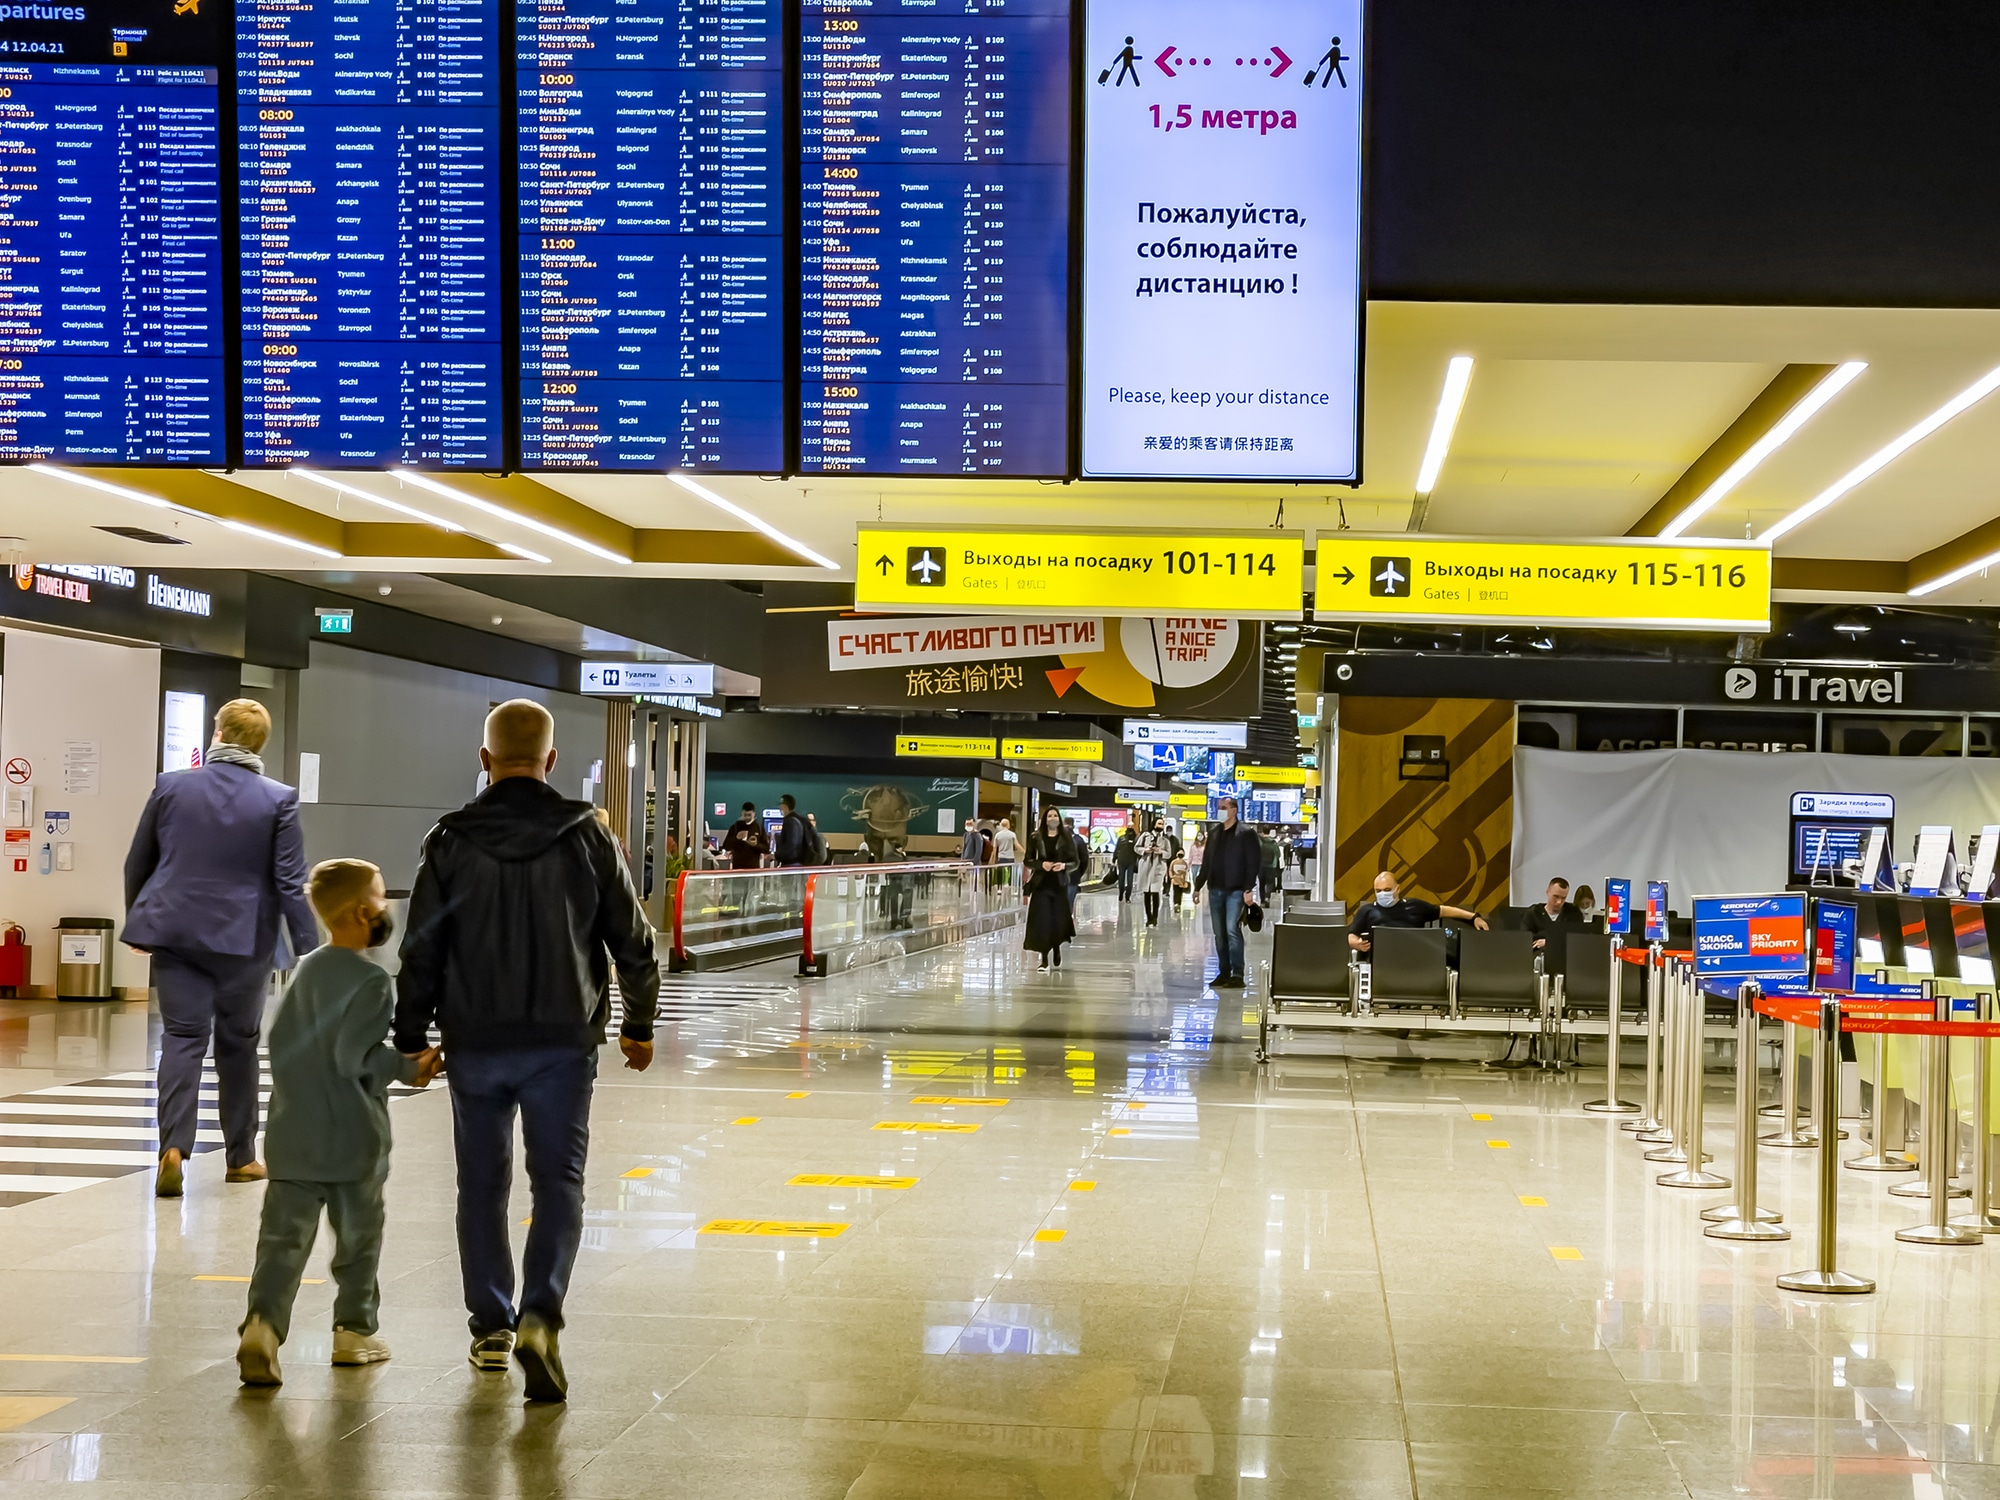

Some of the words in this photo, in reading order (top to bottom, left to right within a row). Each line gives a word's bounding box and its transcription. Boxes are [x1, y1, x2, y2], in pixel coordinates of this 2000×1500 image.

[257, 15, 291, 23] Иркутск
[824, 20, 858, 31] 13:00
[13, 42, 64, 52] 12.04.21
[258, 51, 278, 59] Сочи
[540, 75, 573, 84] 10:00
[539, 90, 583, 98] Волгоград
[616, 90, 653, 98] Volgograd
[55, 105, 96, 113] N.Novgorod
[259, 109, 293, 120] 08:00
[1149, 104, 1193, 132] 1,5
[1202, 109, 1297, 134] метра
[823, 128, 856, 136] Самара
[260, 161, 291, 169] Самара
[824, 168, 858, 178] 14:00
[901, 184, 928, 192] Tyumen
[58, 196, 91, 204] Orenburg
[1137, 202, 1307, 229] Пожалуйста,
[542, 239, 575, 249] 11:00
[1137, 237, 1298, 262] соблюдайте
[61, 268, 83, 276] Surgut
[541, 272, 562, 280] Орск
[823, 275, 869, 283] Краснодар
[1136, 276, 1285, 297] дистанцию
[1292, 273, 1298, 294] !
[823, 311, 849, 319] Магас
[901, 312, 924, 320] Magas
[263, 345, 297, 356] 09:00
[543, 384, 576, 394] 12:00
[824, 387, 857, 397] 15:00
[1109, 388, 1165, 404] Please,
[1171, 388, 1211, 406] keep
[1215, 391, 1253, 406] your
[1258, 389, 1329, 404] distance
[542, 416, 563, 424] Сочи
[265, 431, 281, 440] Уфа
[1144, 436, 1294, 451] 亲爱的乘客请保持距离
[265, 449, 310, 458] Краснодар
[823, 456, 866, 465] Мурманск
[964, 550, 1043, 569] Выходы
[1047, 556, 1068, 567] на
[1075, 555, 1153, 572] посадку
[1163, 551, 1276, 577] 101-114
[1425, 561, 1504, 579] Выходы
[1511, 567, 1531, 578] на
[1538, 567, 1617, 584] посадку
[1628, 562, 1746, 588] 115-116
[35, 574, 64, 597] TRAVEL
[963, 577, 998, 588] Gates
[148, 574, 210, 617] HEINEMANN
[1424, 588, 1460, 600] Gates
[1479, 590, 1509, 601] 登机口
[839, 627, 1017, 657] СЧАСТЛИВОГО
[1023, 621, 1095, 646] ПУТИ!
[1166, 632, 1176, 645] A
[1180, 632, 1215, 646] NICE
[1166, 647, 1207, 662] TRIP!
[625, 671, 657, 679] Туалеты
[906, 663, 1024, 697] 旅途愉快!
[1773, 670, 1902, 703] iTravel
[1820, 799, 1847, 807] Зарядка
[1849, 800, 1886, 808] телефонов
[1699, 935, 1734, 943] КЛАСС
[1751, 940, 1798, 948] PRIORITY
[1700, 942, 1742, 951] ЭКОНОМ
